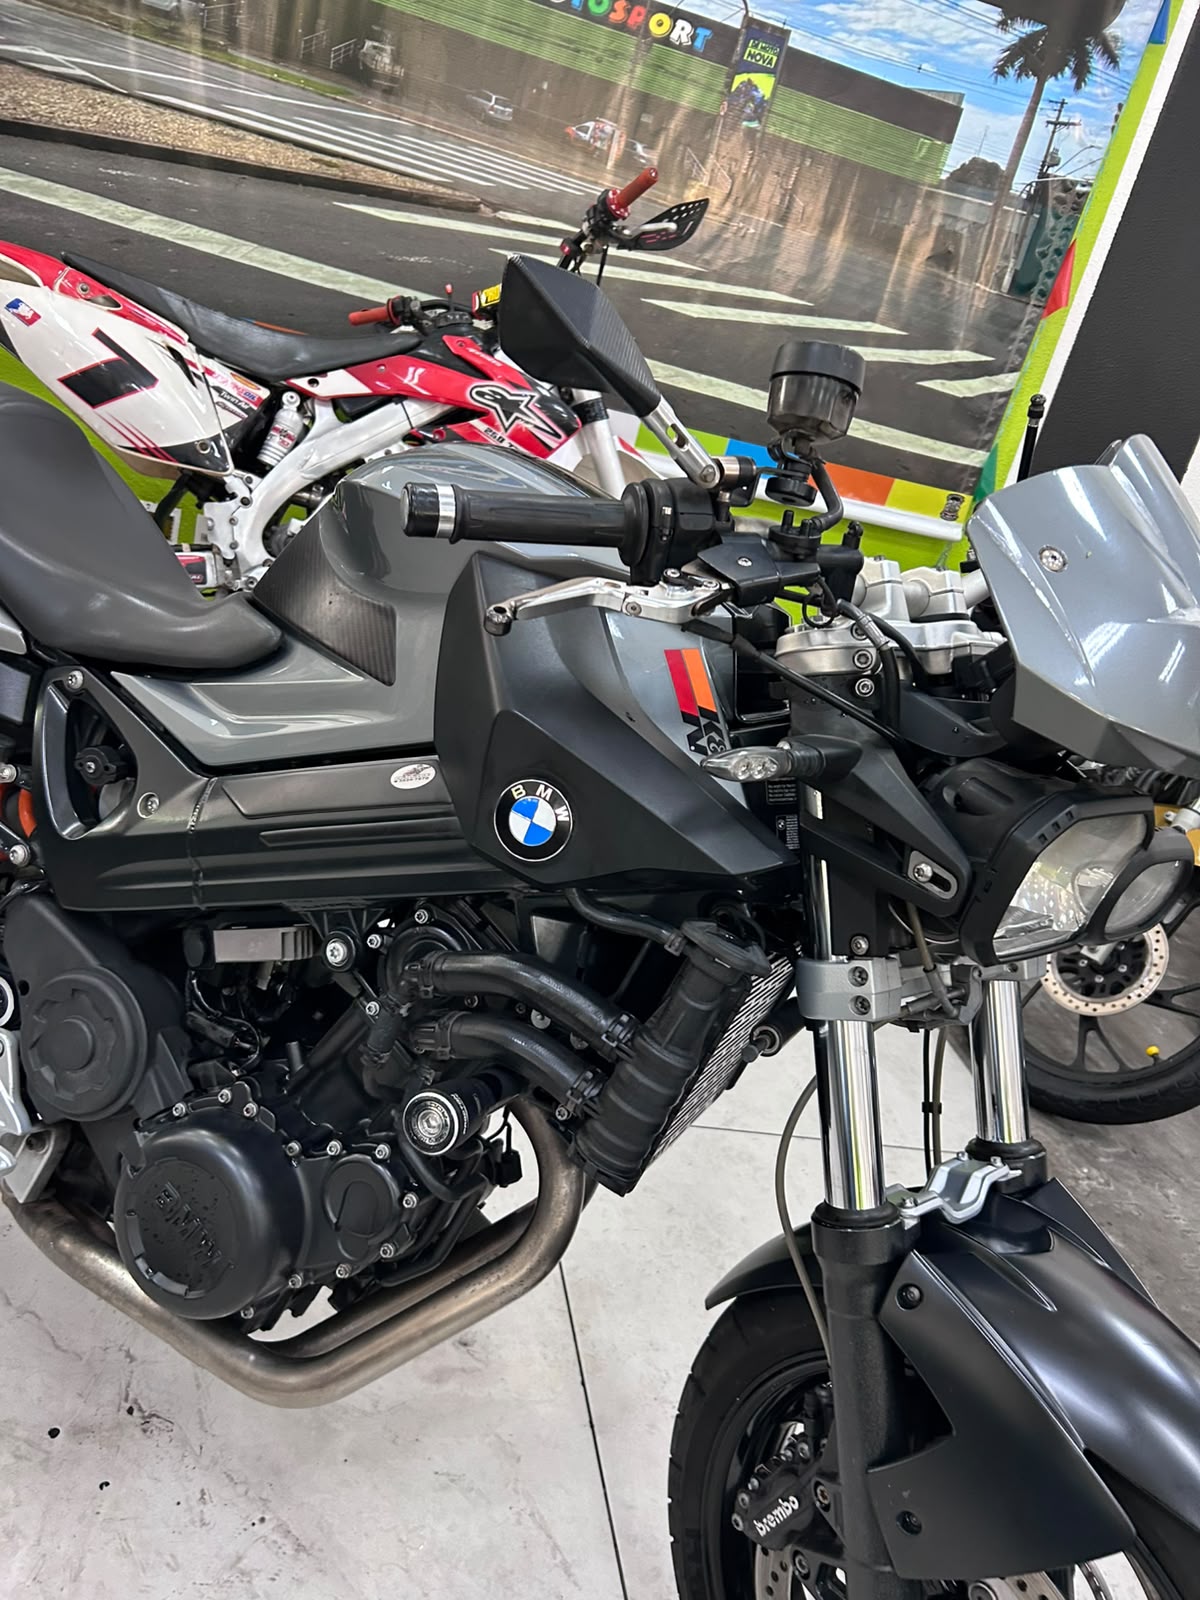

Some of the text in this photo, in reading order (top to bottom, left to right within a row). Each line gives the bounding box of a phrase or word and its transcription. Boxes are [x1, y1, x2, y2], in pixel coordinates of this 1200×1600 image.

[550, 0, 713, 52] OSPORT
[746, 48, 775, 67] NOVA
[510, 783, 571, 823] BMW
[752, 1495, 800, 1537] brembo
